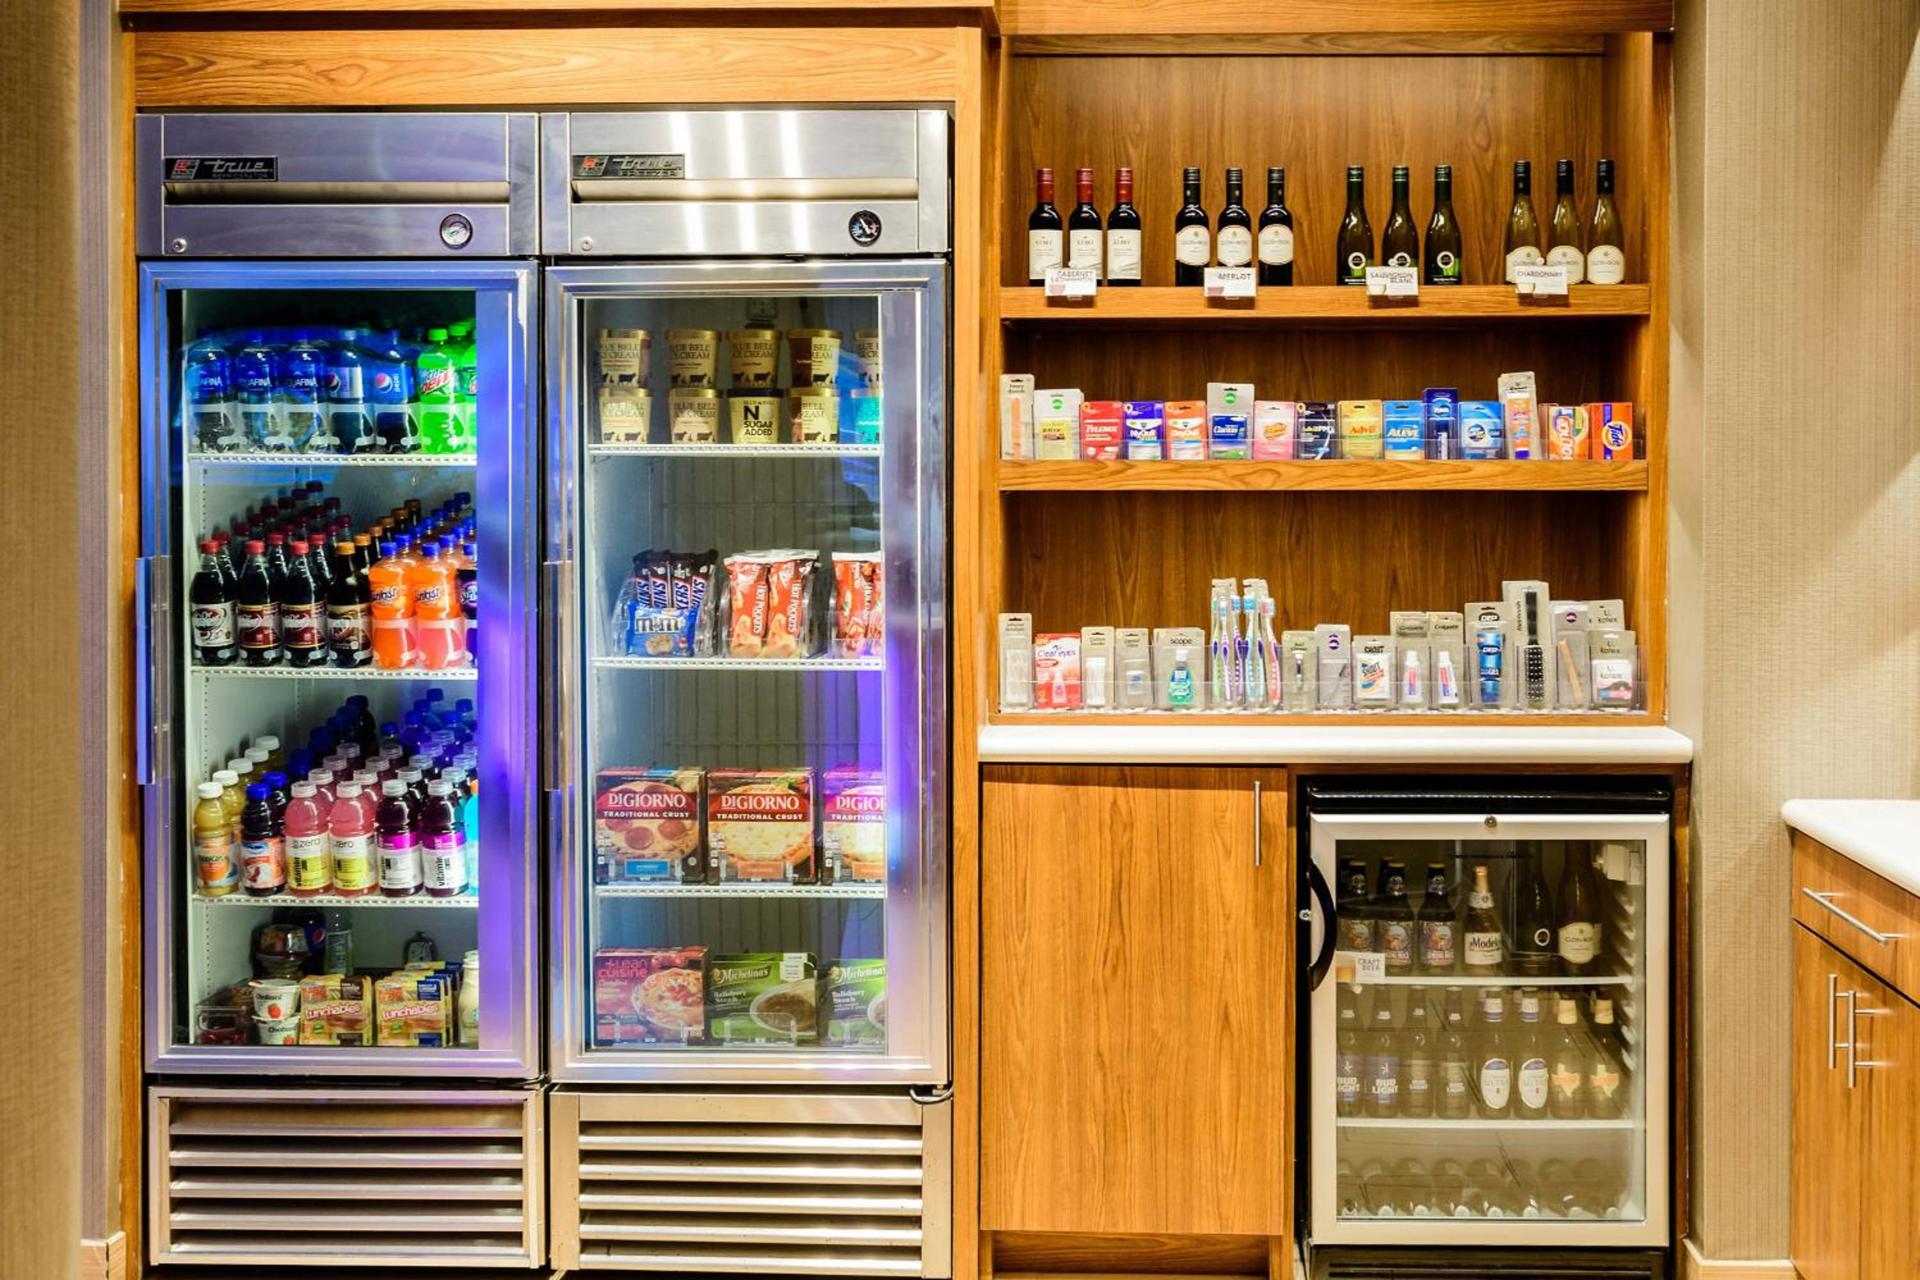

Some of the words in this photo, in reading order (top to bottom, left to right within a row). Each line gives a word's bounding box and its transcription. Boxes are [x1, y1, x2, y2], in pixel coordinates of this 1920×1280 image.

[204, 160, 270, 172] true
[744, 428, 773, 436] ADDED
[1607, 423, 1624, 448] Tide
[1170, 637, 1193, 647] scope
[597, 967, 648, 978] cuisine
[305, 1002, 361, 1020] Lunchables
[383, 1003, 438, 1020] Lunchables
[1376, 1078, 1397, 1086] BUD
[1372, 1085, 1399, 1094] LIGHT
